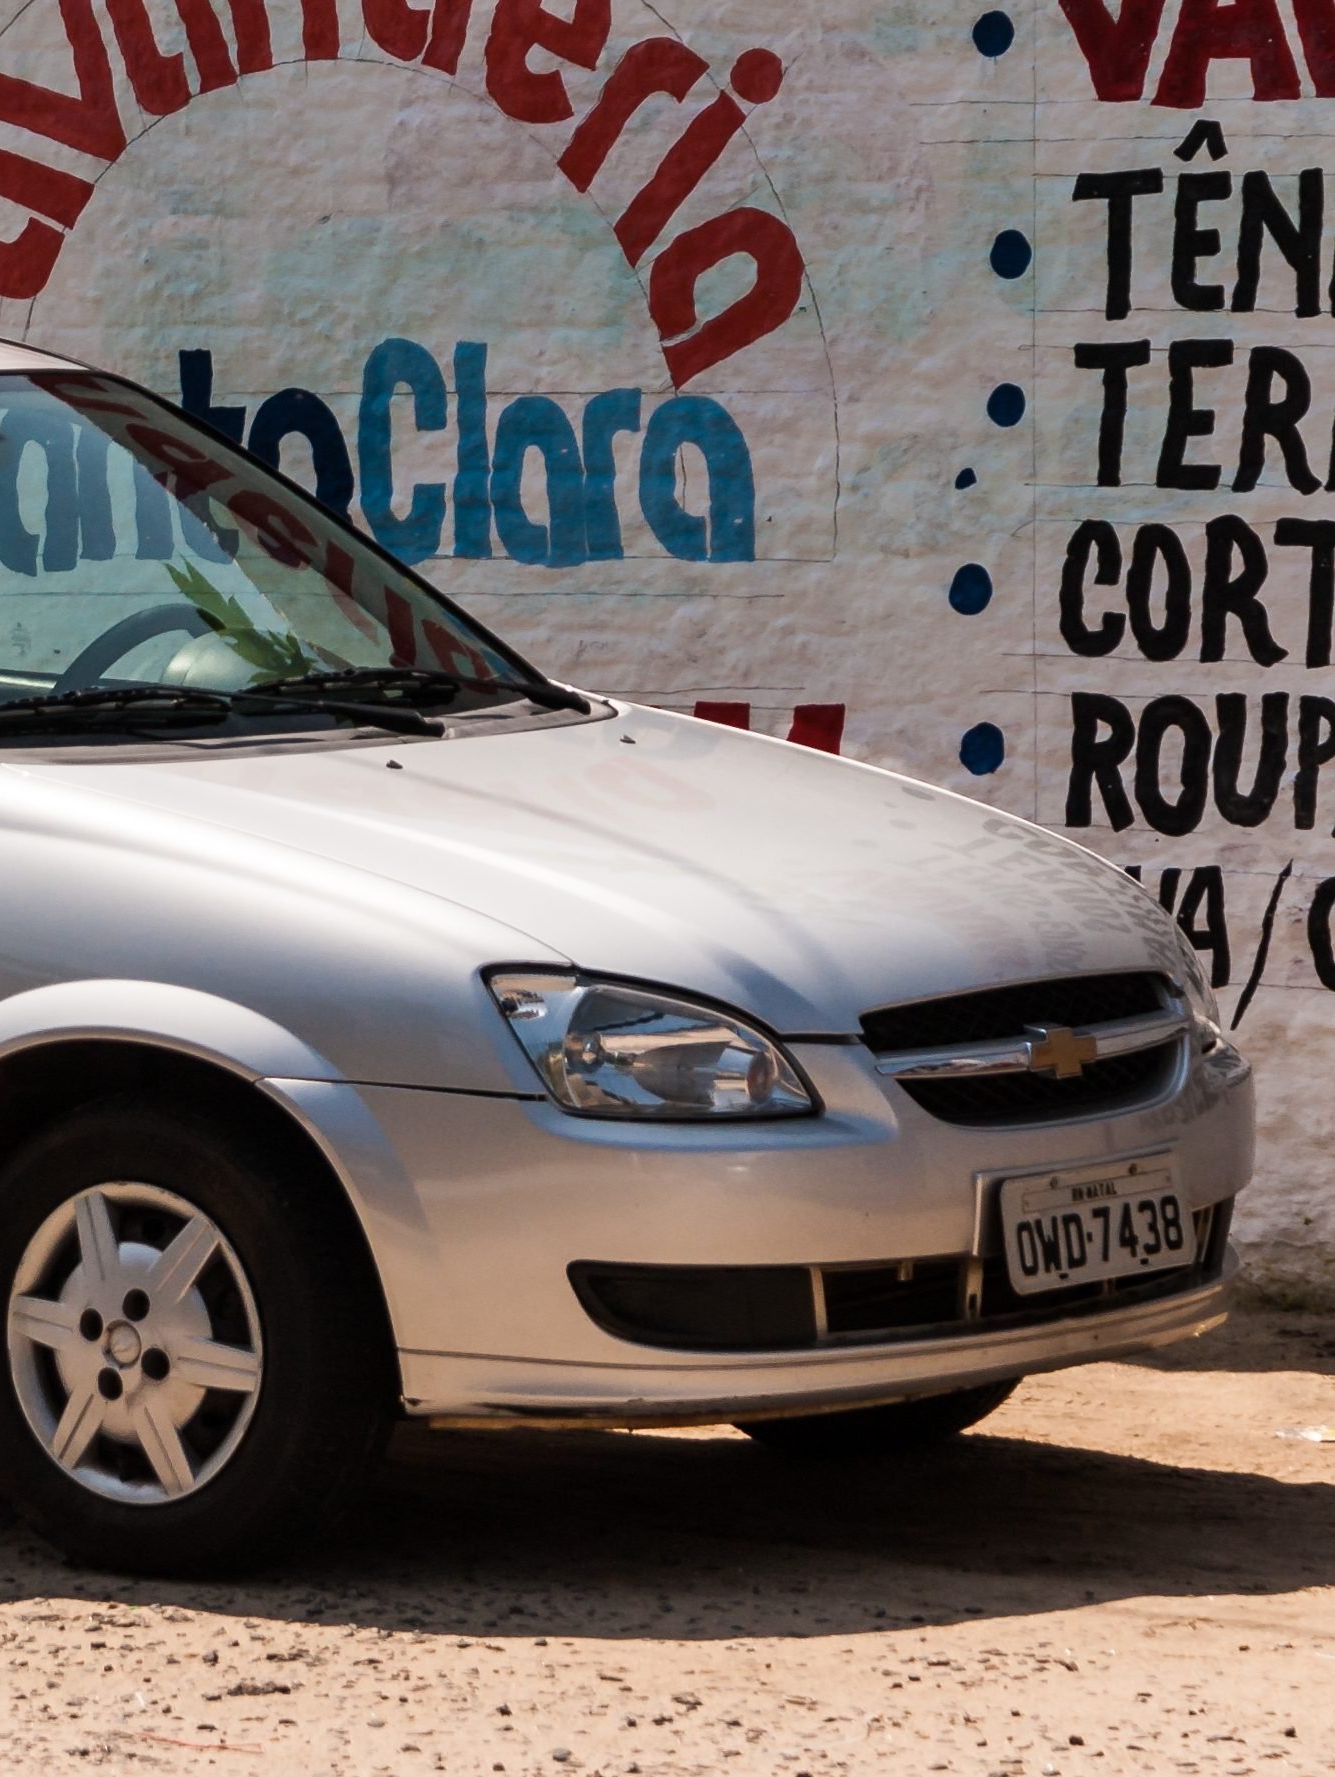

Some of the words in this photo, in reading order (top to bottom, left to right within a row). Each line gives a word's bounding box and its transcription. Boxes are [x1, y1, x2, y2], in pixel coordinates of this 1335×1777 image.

[1072, 118, 1335, 321] TÊN
[1074, 338, 1335, 495] TER
[1059, 514, 1335, 669] CORT
[1065, 691, 1335, 837] ROUP
